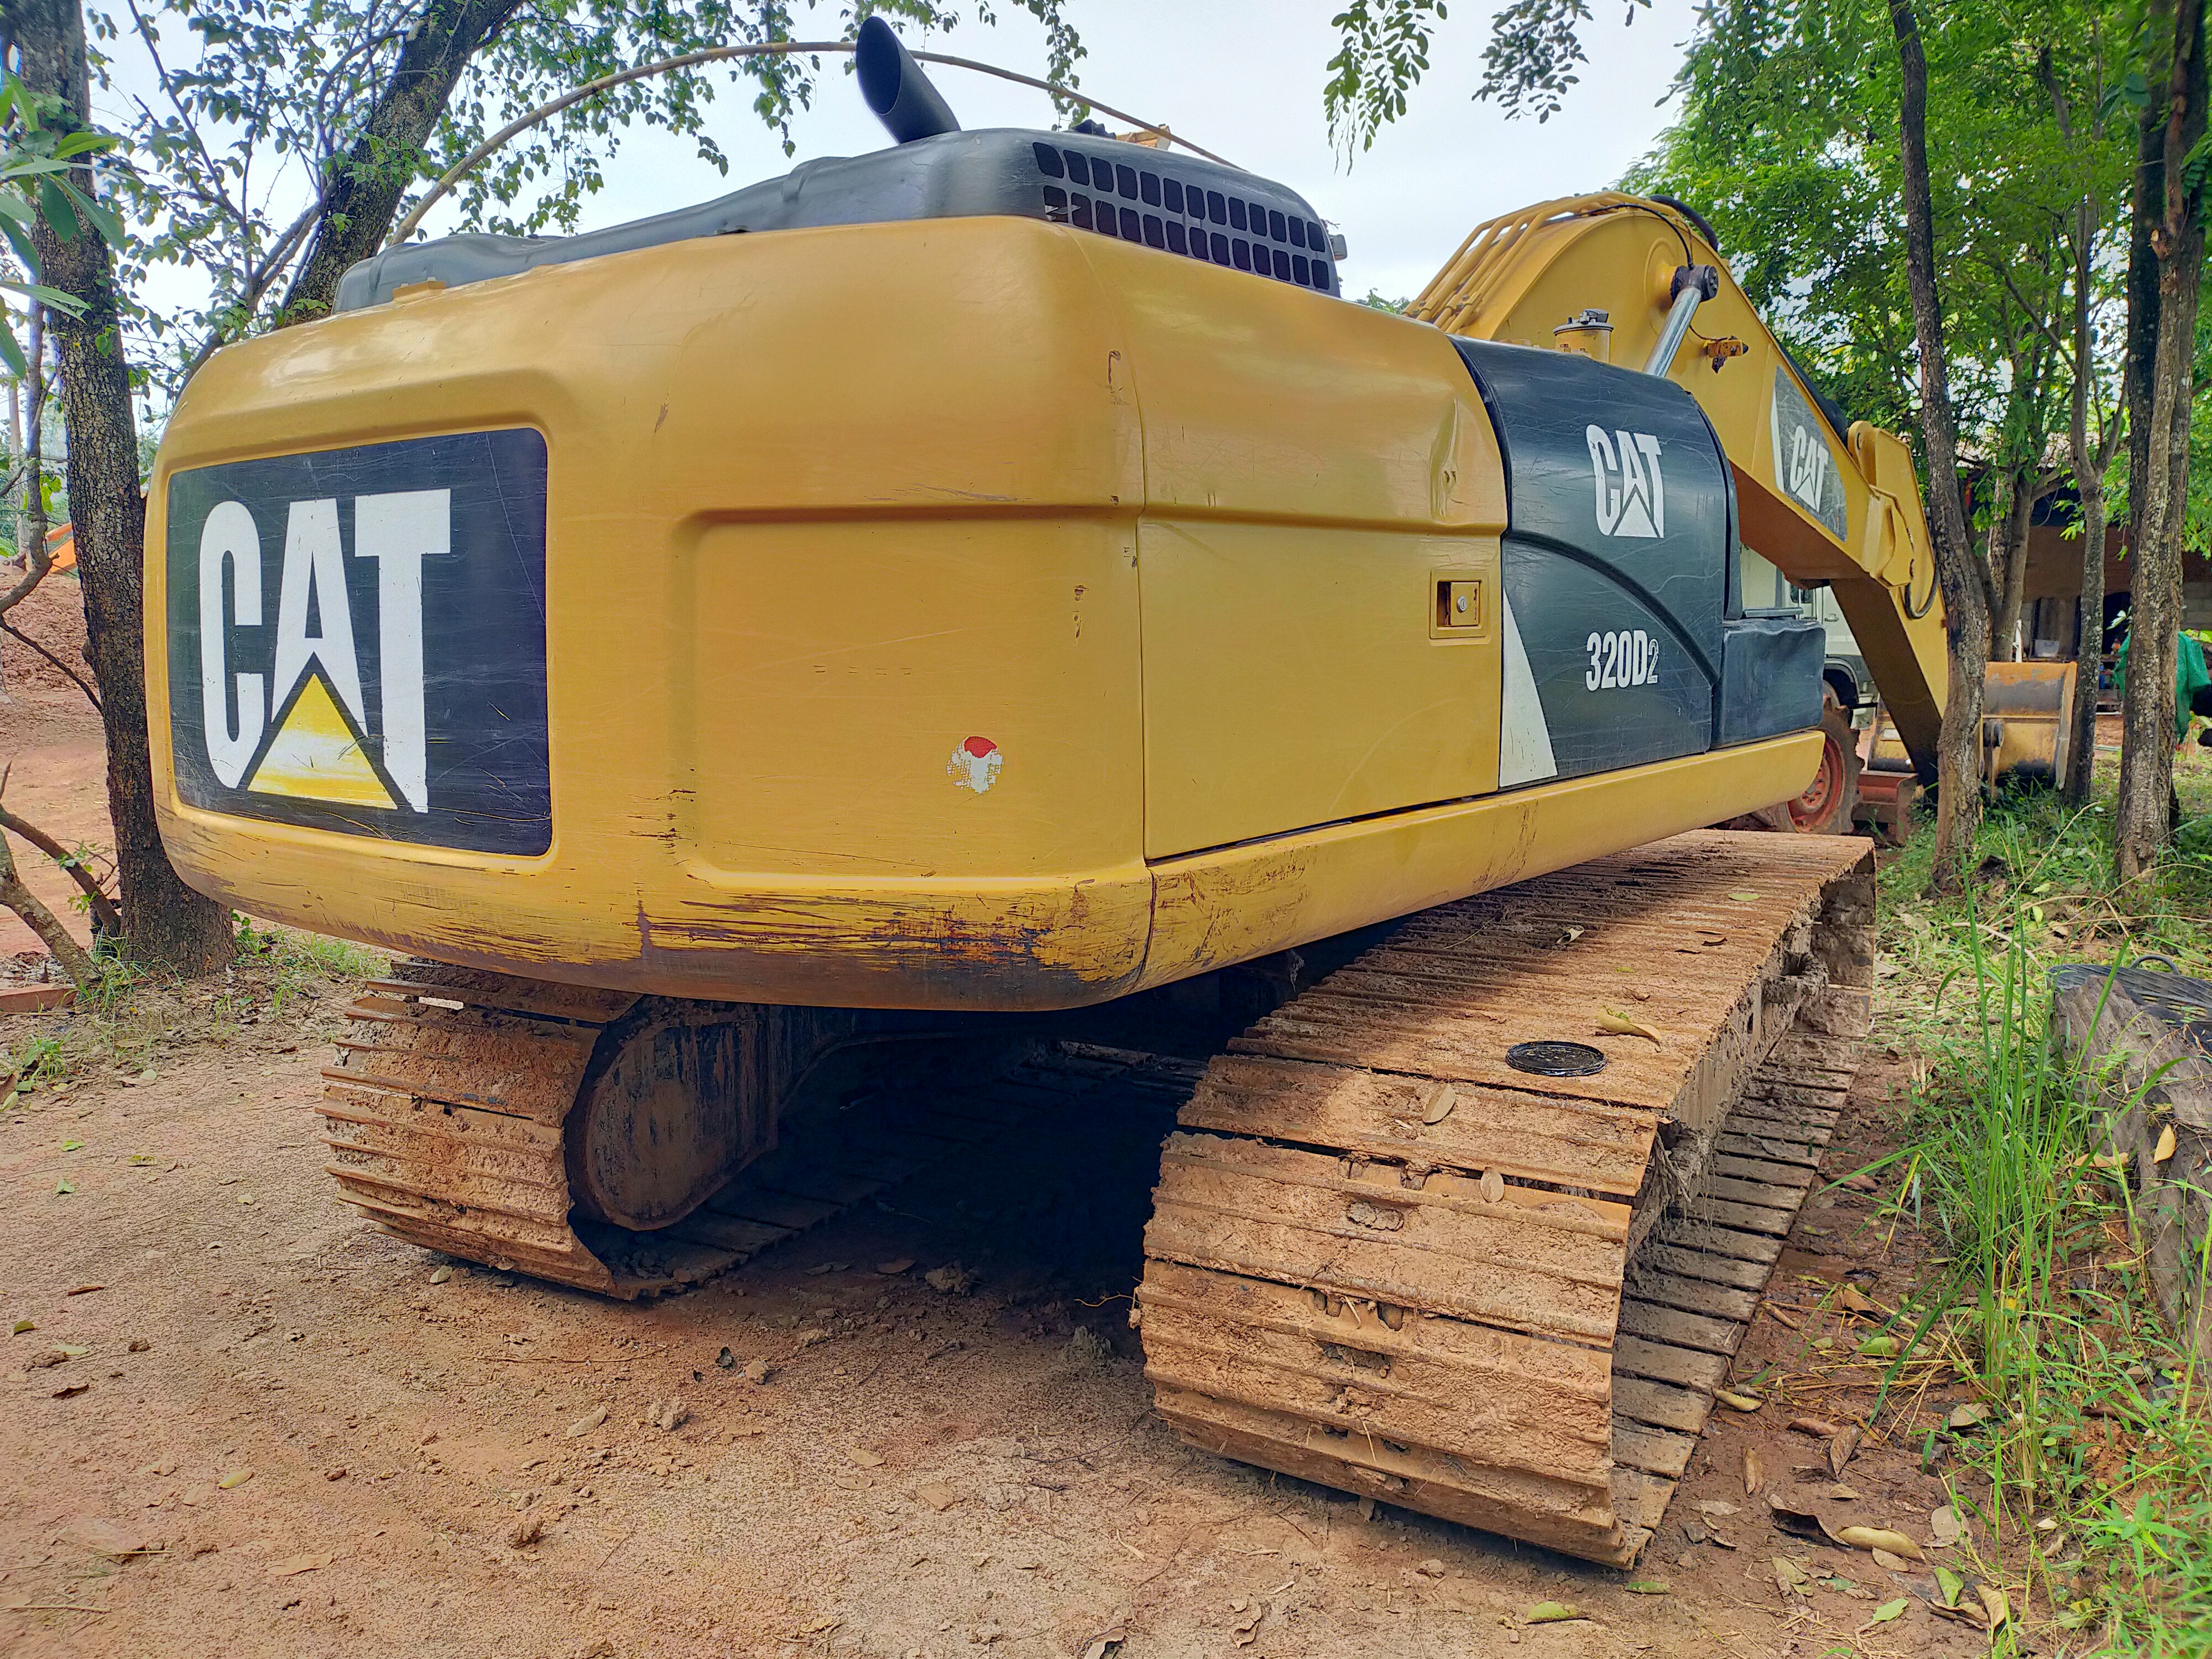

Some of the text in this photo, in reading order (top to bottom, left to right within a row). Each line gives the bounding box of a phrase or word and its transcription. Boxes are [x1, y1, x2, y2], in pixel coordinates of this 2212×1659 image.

[1586, 424, 1664, 538] CAT
[1790, 425, 1829, 512] CAT
[200, 488, 451, 813] CAT
[1585, 629, 1659, 691] 320D2
